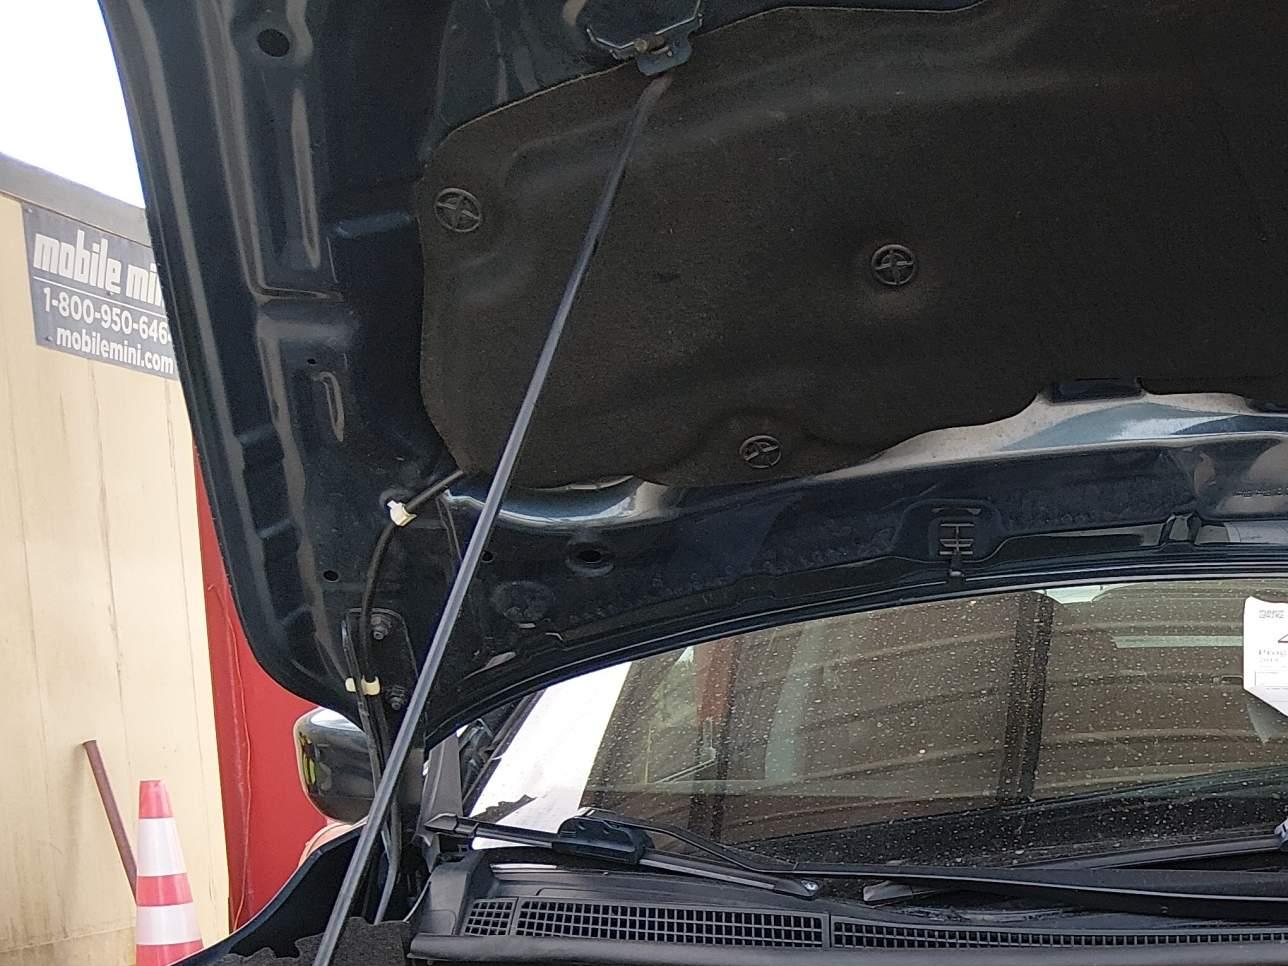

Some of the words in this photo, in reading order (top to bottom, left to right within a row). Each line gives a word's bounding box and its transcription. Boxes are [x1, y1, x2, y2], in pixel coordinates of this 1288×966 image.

[33, 229, 122, 294] mobile
[43, 287, 172, 345] 1-800-950-646
[56, 326, 174, 374] mobilemini.com
